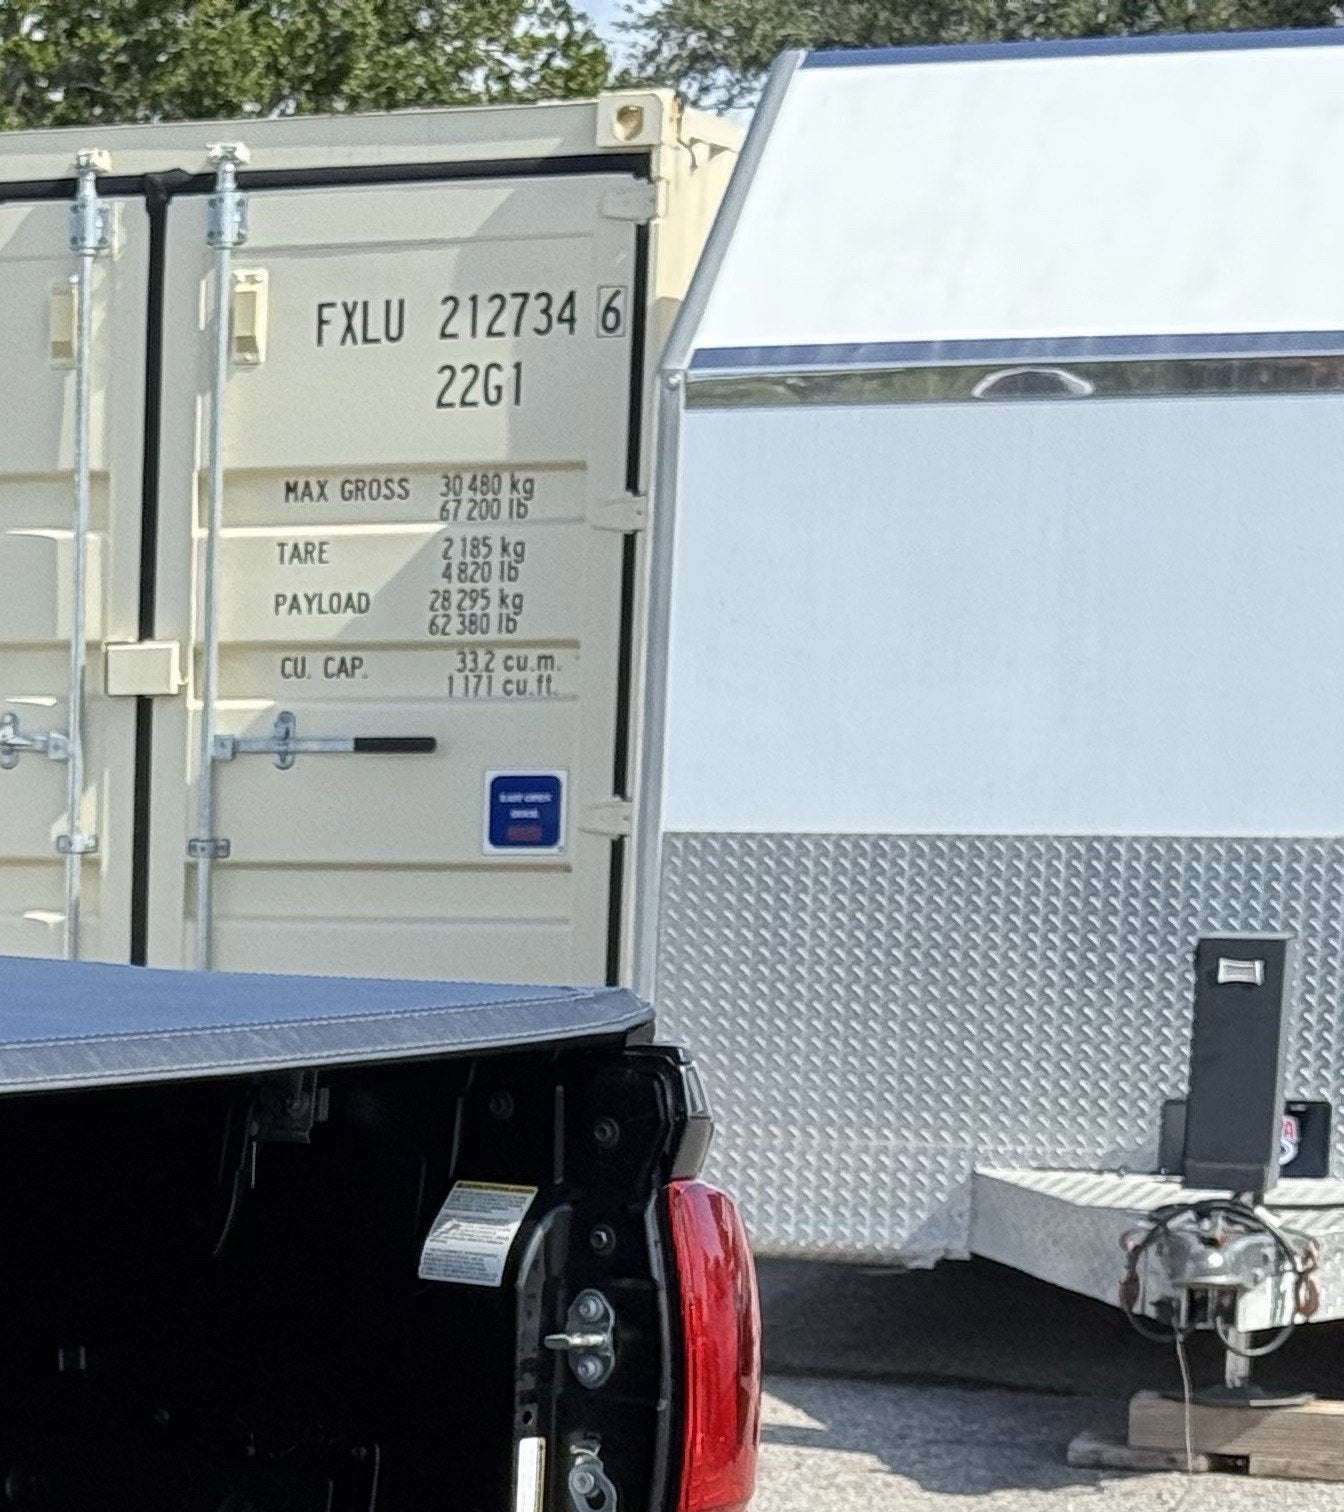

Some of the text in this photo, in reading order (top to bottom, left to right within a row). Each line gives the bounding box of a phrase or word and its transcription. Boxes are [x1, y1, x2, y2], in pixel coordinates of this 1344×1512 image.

[317, 290, 621, 347] FXLU 212734 6
[435, 361, 523, 409] 22G1
[284, 477, 411, 502] MAX GROSS
[510, 475, 535, 499] kg
[508, 497, 528, 520] lb
[277, 542, 330, 565] TARE
[500, 538, 526, 564] kg
[500, 561, 519, 583] lb
[274, 592, 371, 616] PAYLOAD
[499, 588, 524, 615] kg
[498, 613, 518, 634] lb
[281, 656, 368, 679] CU. CAP.
